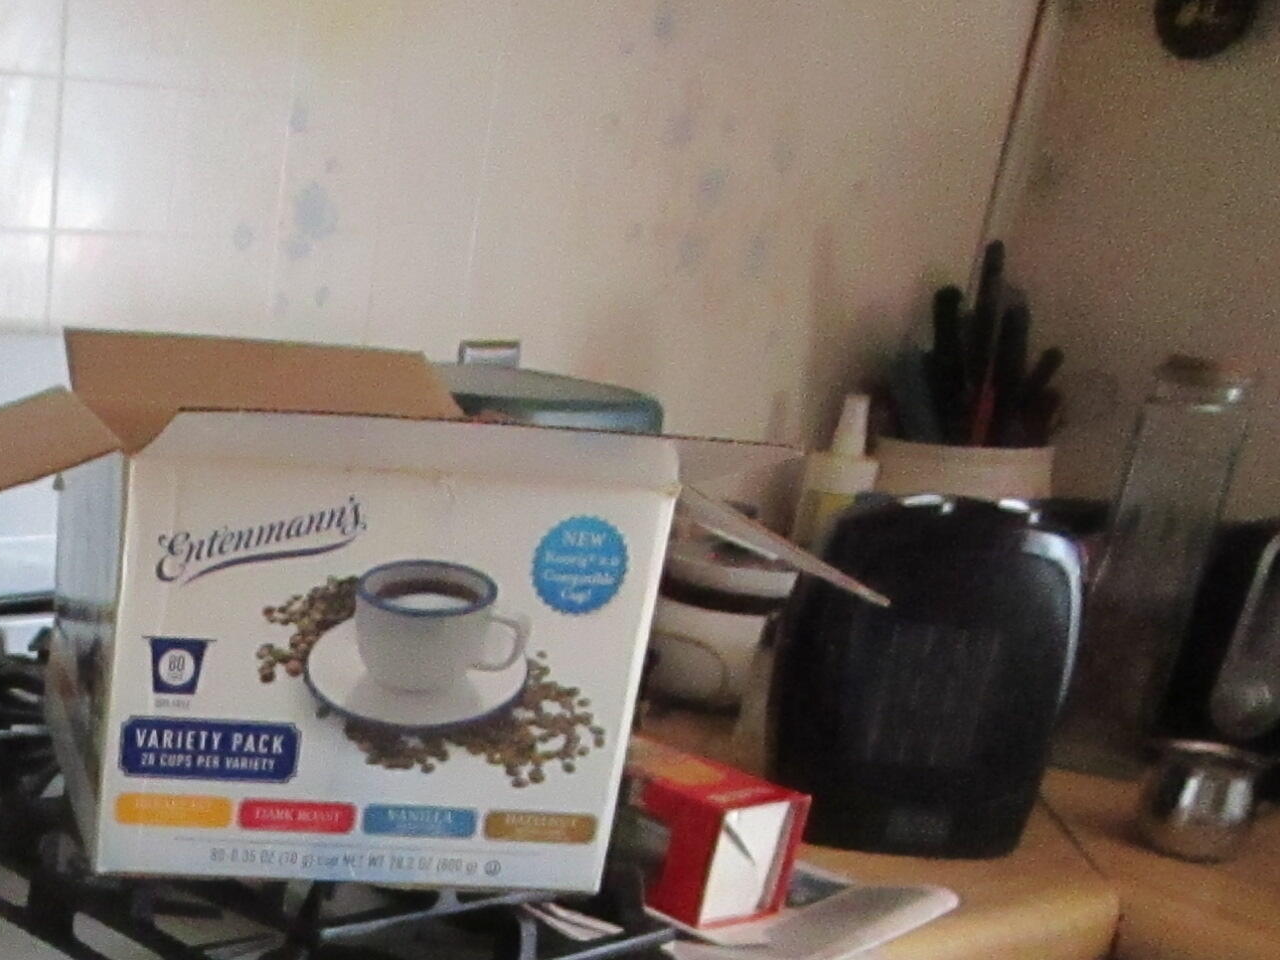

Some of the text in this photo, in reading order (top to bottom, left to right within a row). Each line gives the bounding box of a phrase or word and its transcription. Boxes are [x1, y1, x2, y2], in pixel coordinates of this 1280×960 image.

[155, 496, 366, 582] Entenmann's
[561, 530, 606, 546] NEW
[136, 728, 285, 754] VARIETY PACK
[160, 753, 193, 767] CUPS
[197, 755, 220, 769] PER
[226, 757, 275, 772] VARIETY
[255, 807, 294, 821] DARK
